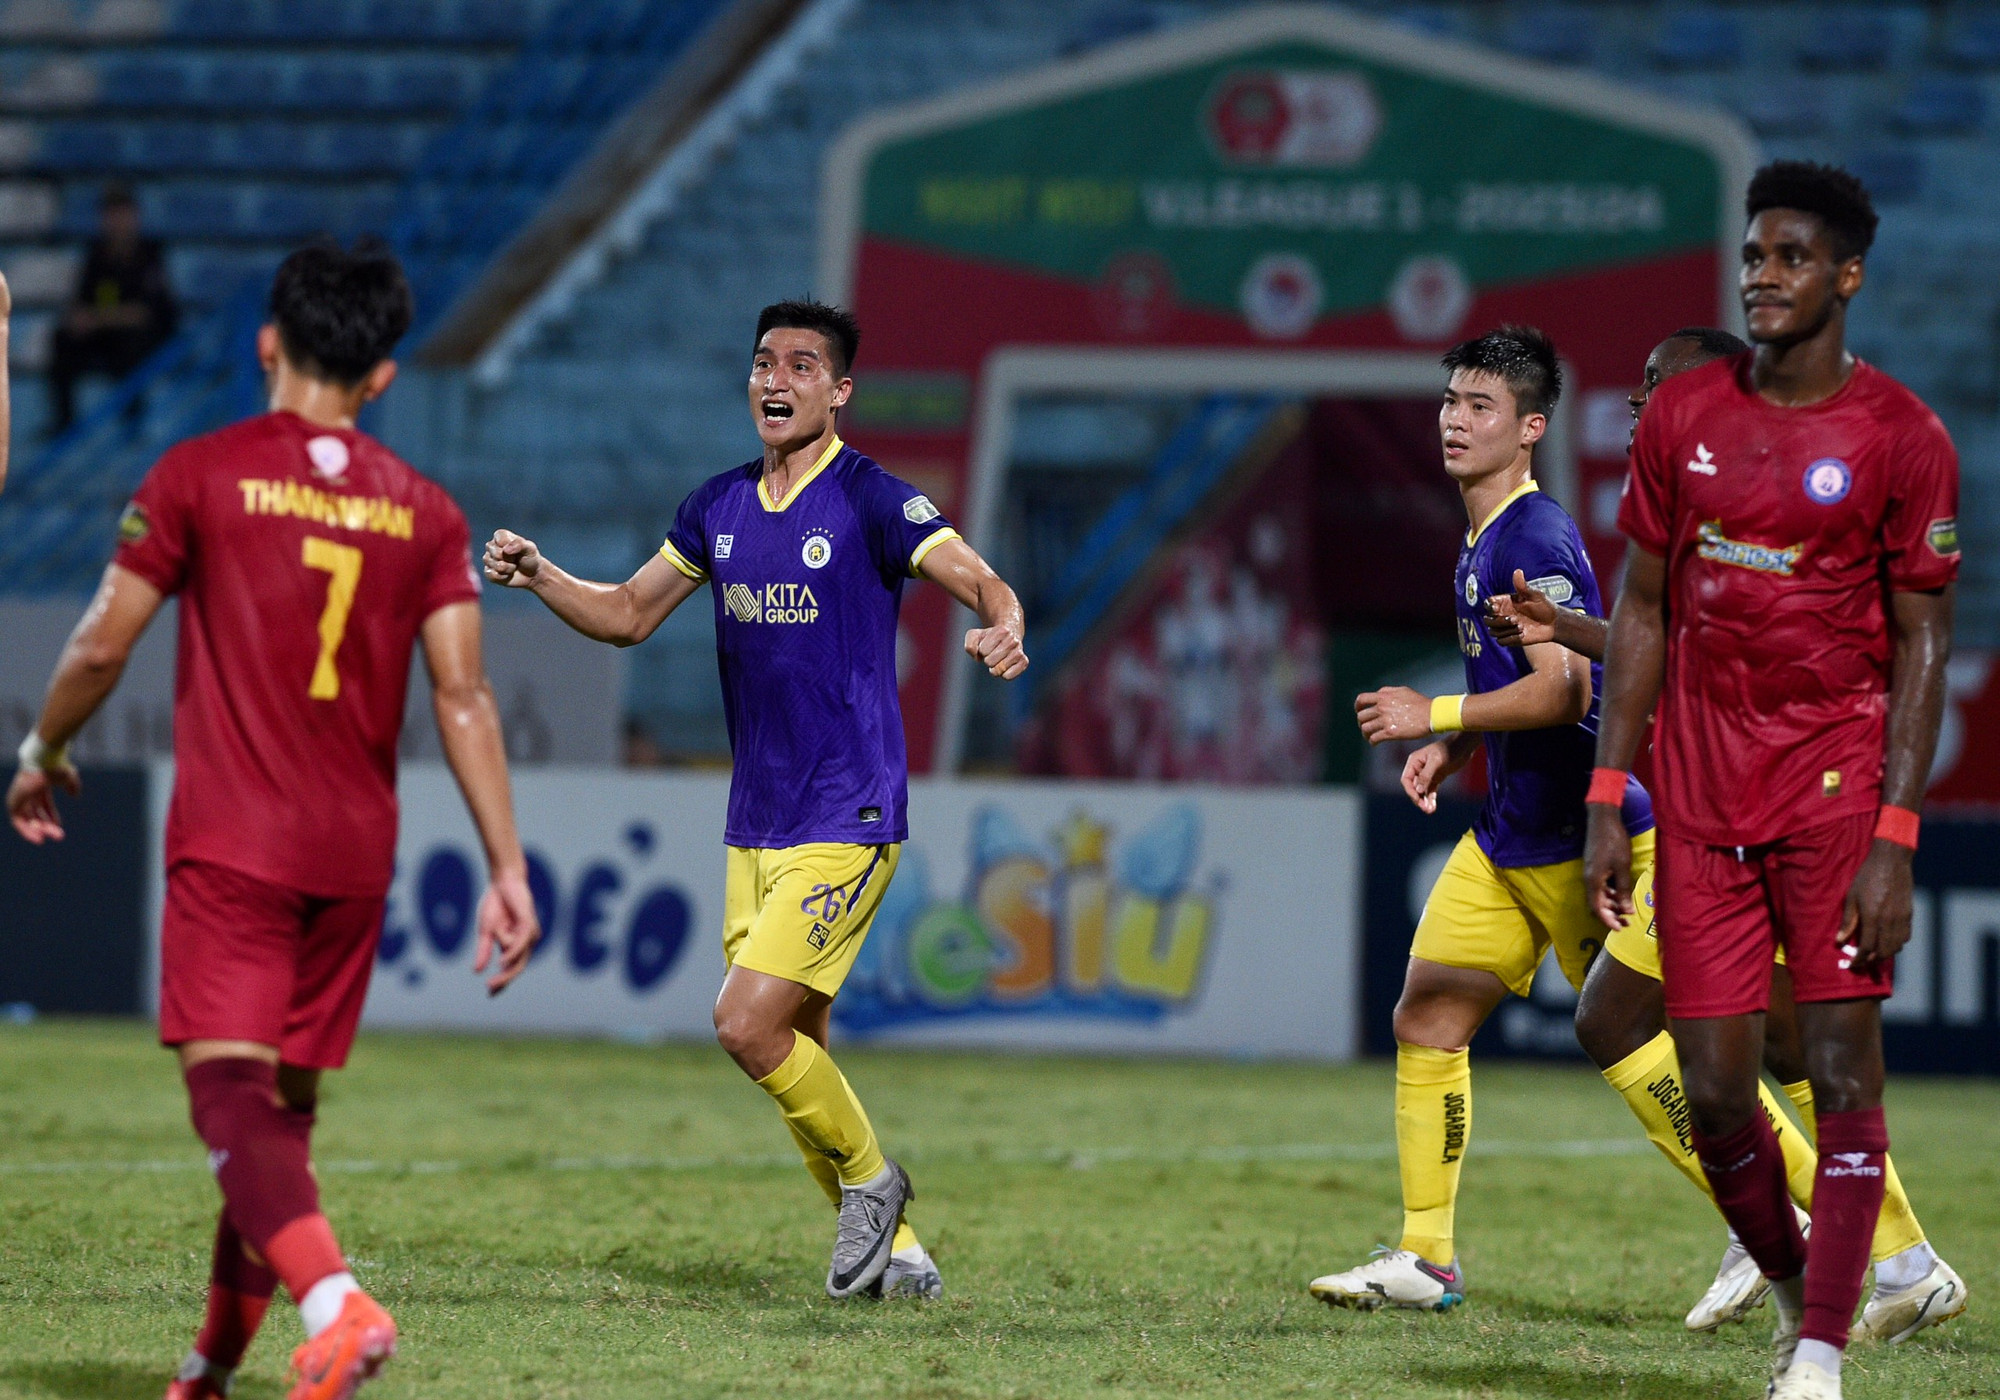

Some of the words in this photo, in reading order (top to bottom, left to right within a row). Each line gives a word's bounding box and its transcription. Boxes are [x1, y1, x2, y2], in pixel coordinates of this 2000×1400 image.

[765, 583, 818, 607] KITA
[302, 535, 363, 700] 7
[765, 608, 819, 623] GROUP
[801, 883, 846, 923] 26
[1441, 1091, 1465, 1164] JOGARBOLA
